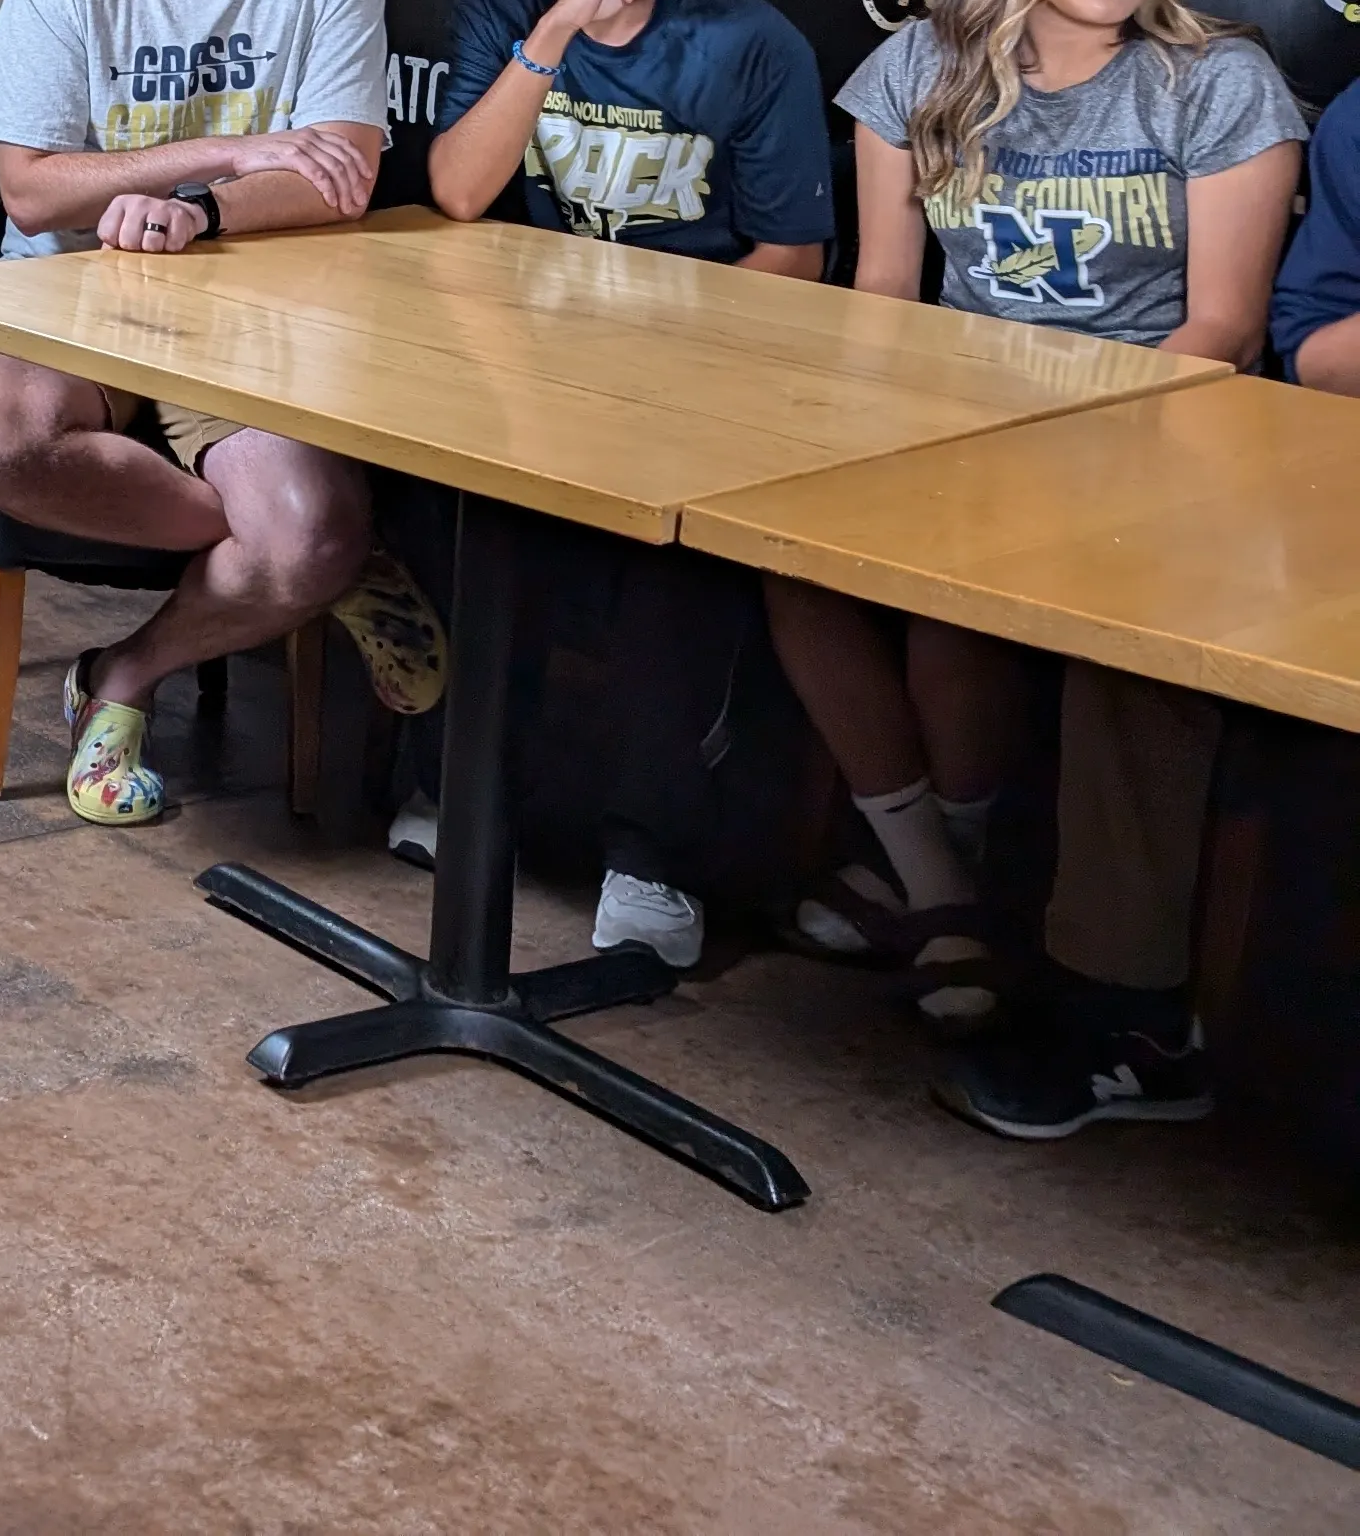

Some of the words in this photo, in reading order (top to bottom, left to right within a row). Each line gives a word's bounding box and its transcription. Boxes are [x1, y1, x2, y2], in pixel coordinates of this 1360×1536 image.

[132, 33, 256, 102] CROSS
[574, 101, 605, 123] NOLL
[607, 105, 663, 130] INSTITUTE
[1015, 172, 1173, 248] COUNTRY
